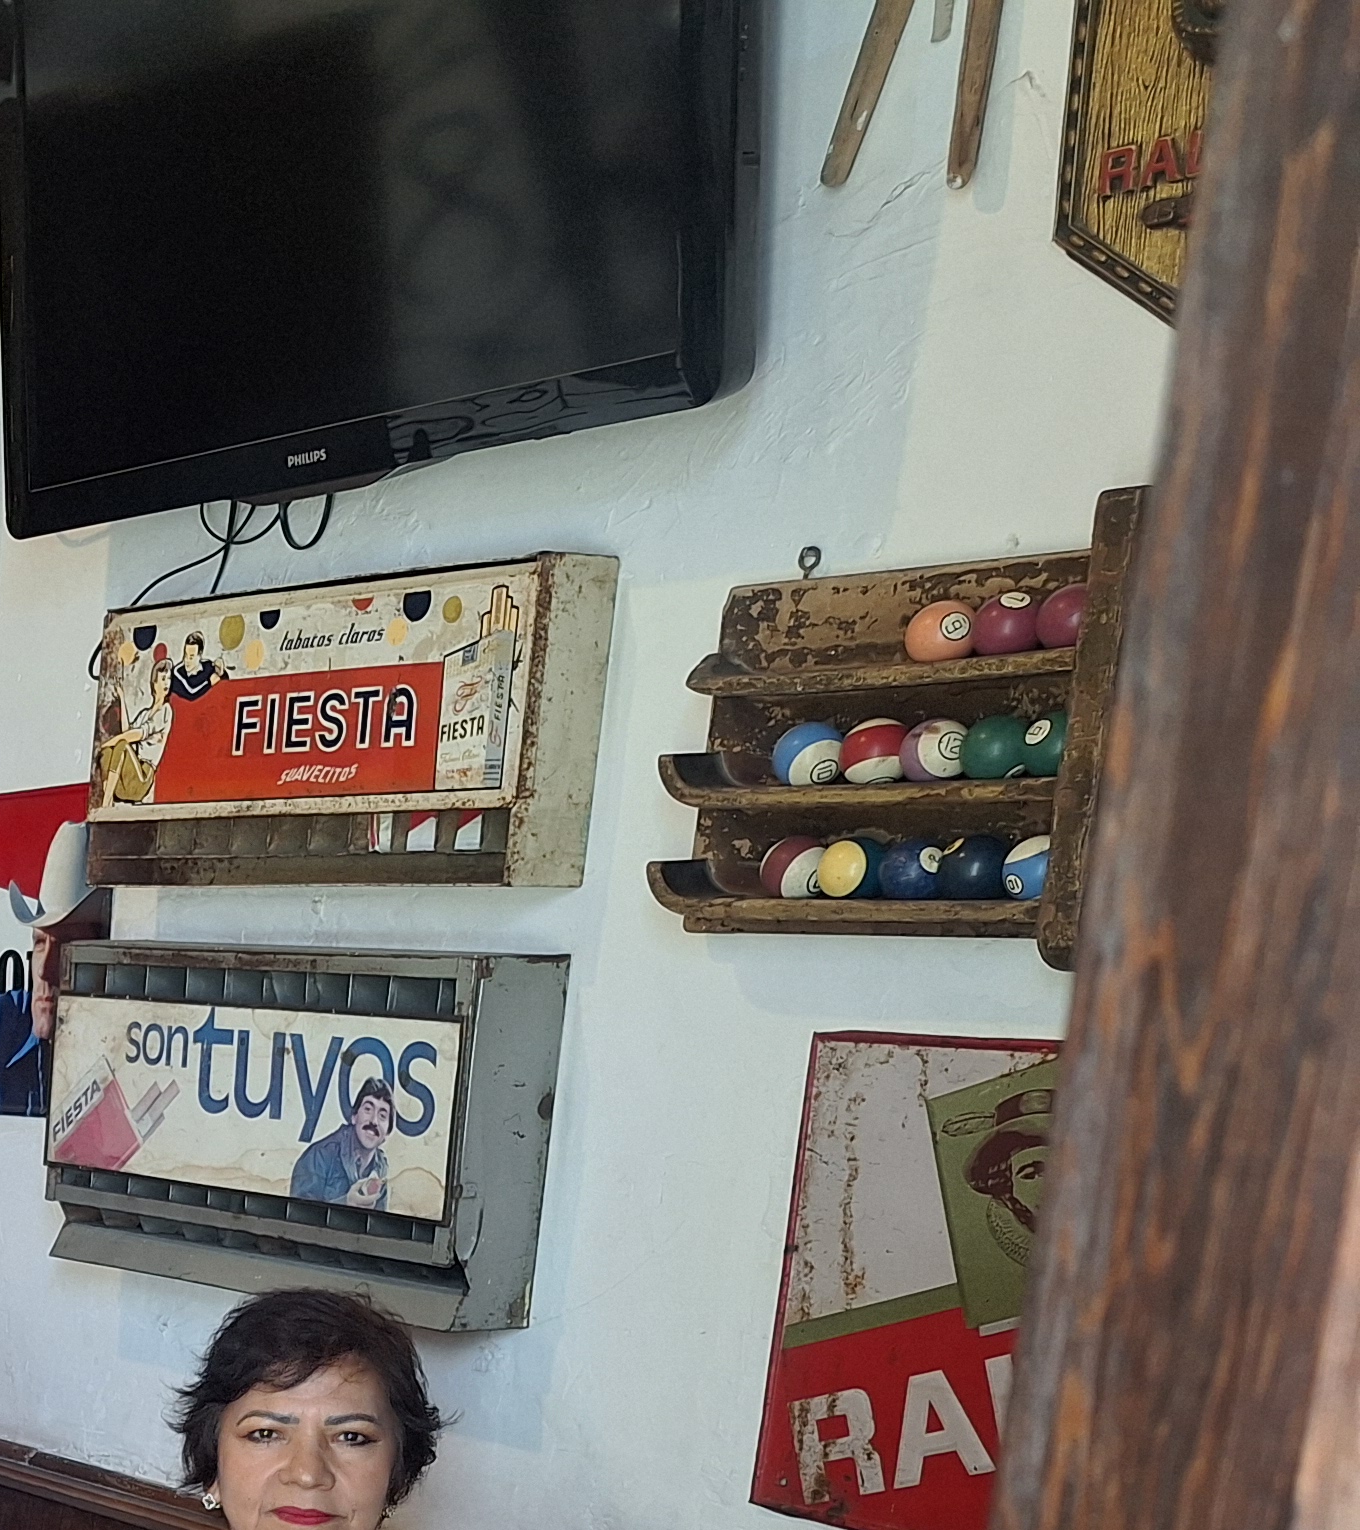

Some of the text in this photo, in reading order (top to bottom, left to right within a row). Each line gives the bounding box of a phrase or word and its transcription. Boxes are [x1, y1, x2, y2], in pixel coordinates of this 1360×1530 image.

[287, 448, 327, 468] PHILIPS
[280, 622, 386, 652] tabacos claros
[494, 675, 506, 721] FIESTA
[232, 684, 418, 757] FIESTA
[439, 714, 485, 743] FIESTA
[277, 763, 359, 786] SUAVECITOS
[125, 1006, 438, 1144] son tuyos
[51, 1079, 102, 1143] FIESTA
